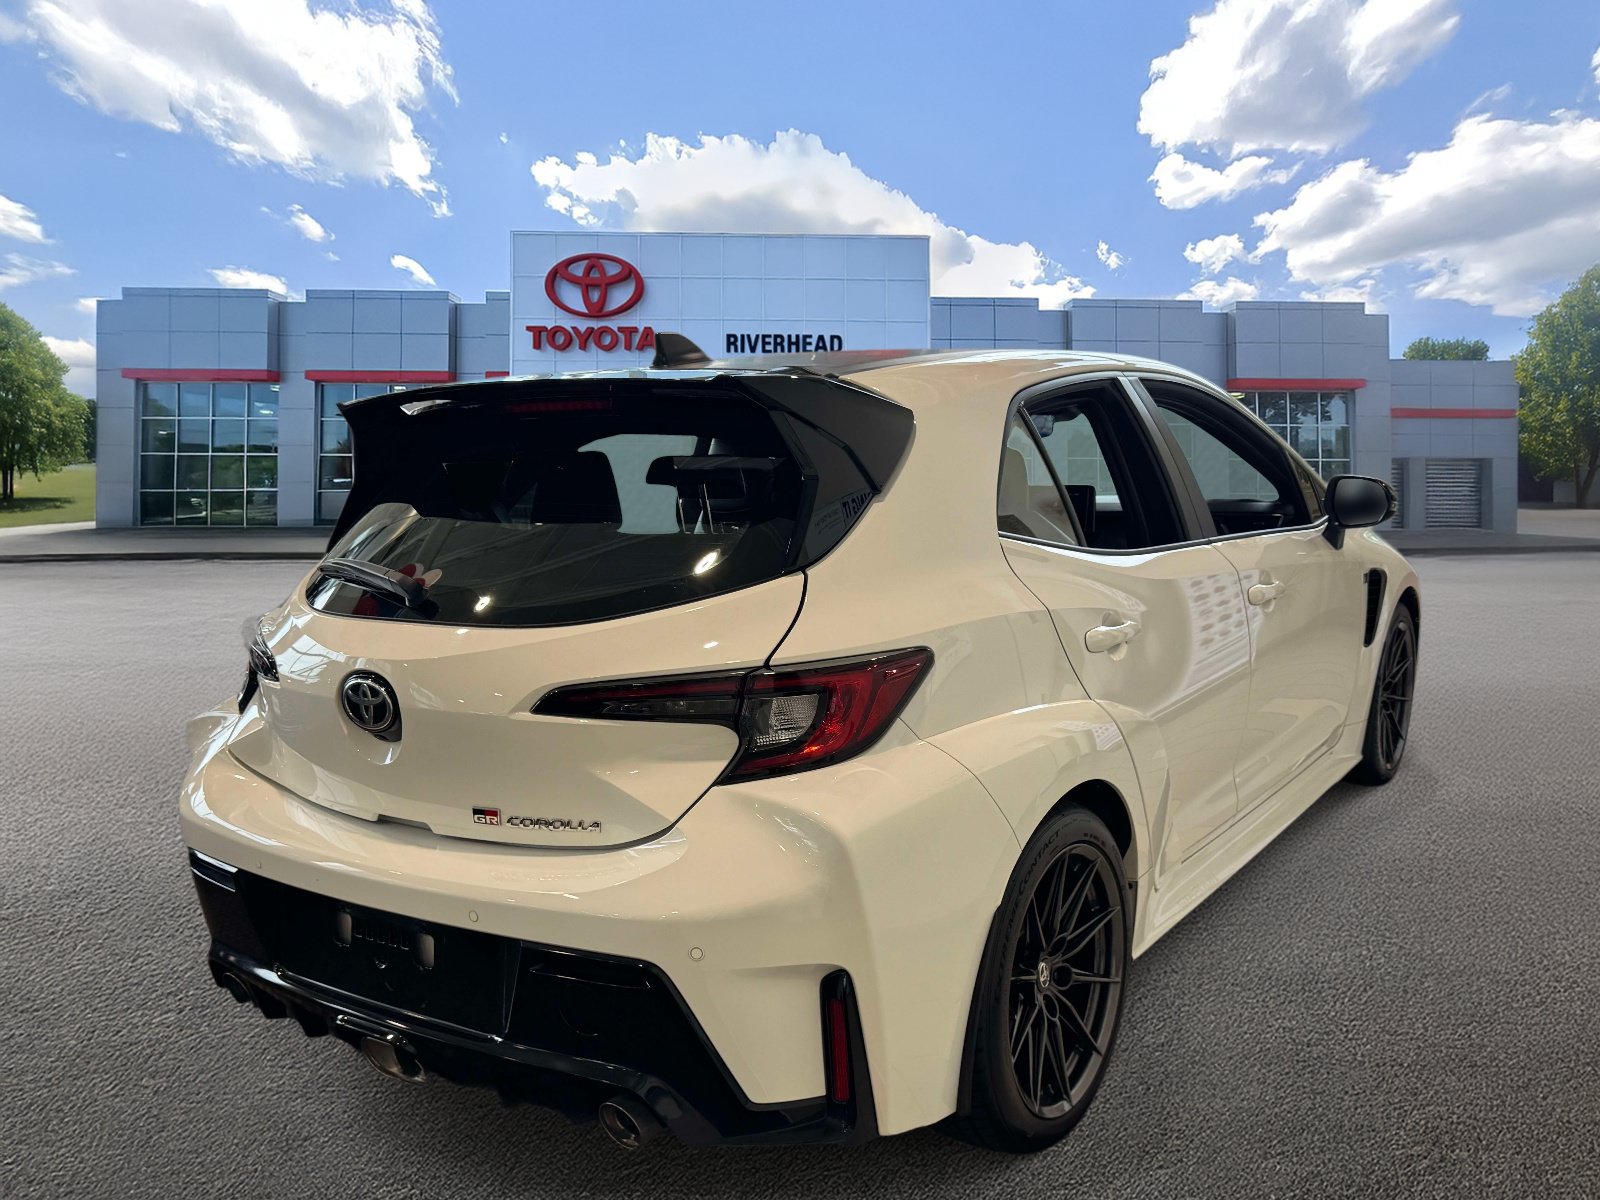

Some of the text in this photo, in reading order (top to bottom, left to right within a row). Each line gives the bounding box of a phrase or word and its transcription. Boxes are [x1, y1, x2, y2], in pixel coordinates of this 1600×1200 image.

[526, 325, 656, 351] TOYOTA
[725, 333, 844, 353] RIVERHEAD
[474, 814, 602, 832] GR COROLLA
